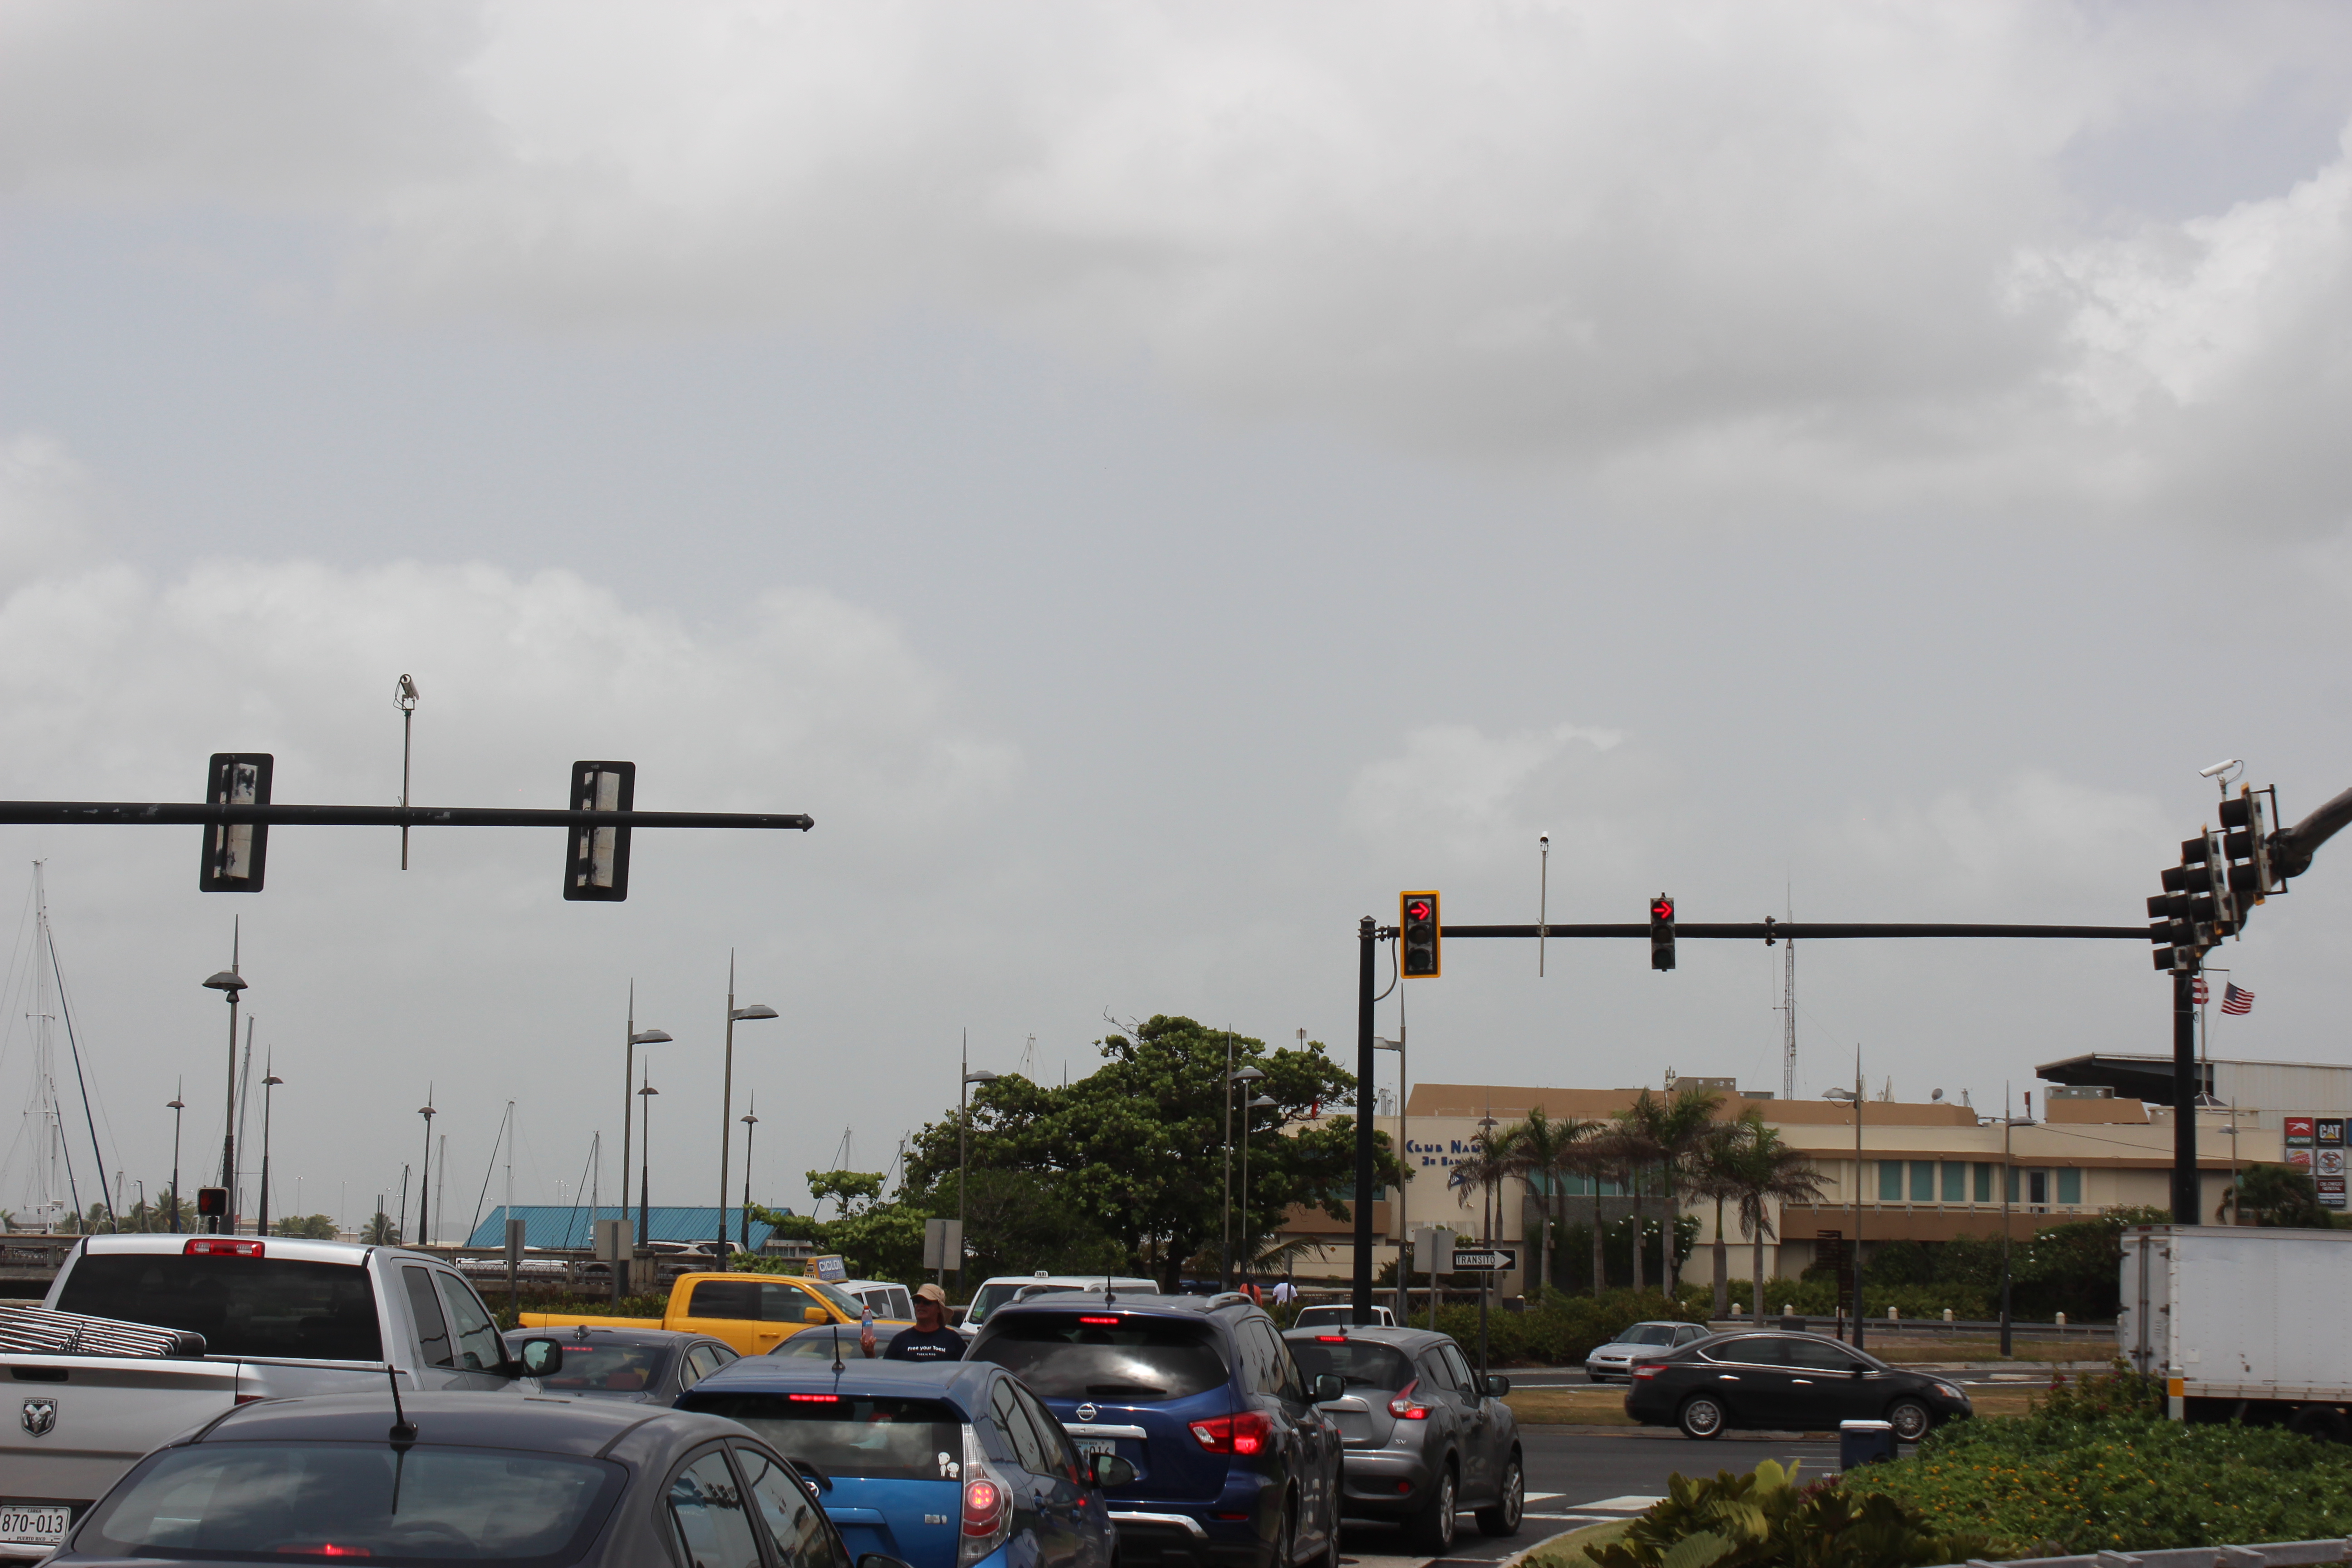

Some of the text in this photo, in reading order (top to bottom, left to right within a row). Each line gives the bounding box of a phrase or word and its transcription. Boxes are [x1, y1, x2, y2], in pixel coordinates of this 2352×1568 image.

[2319, 1124, 2341, 1139] CAT
[1457, 1256, 1495, 1264] TRANSITO
[2, 1514, 63, 1533] 870-013
